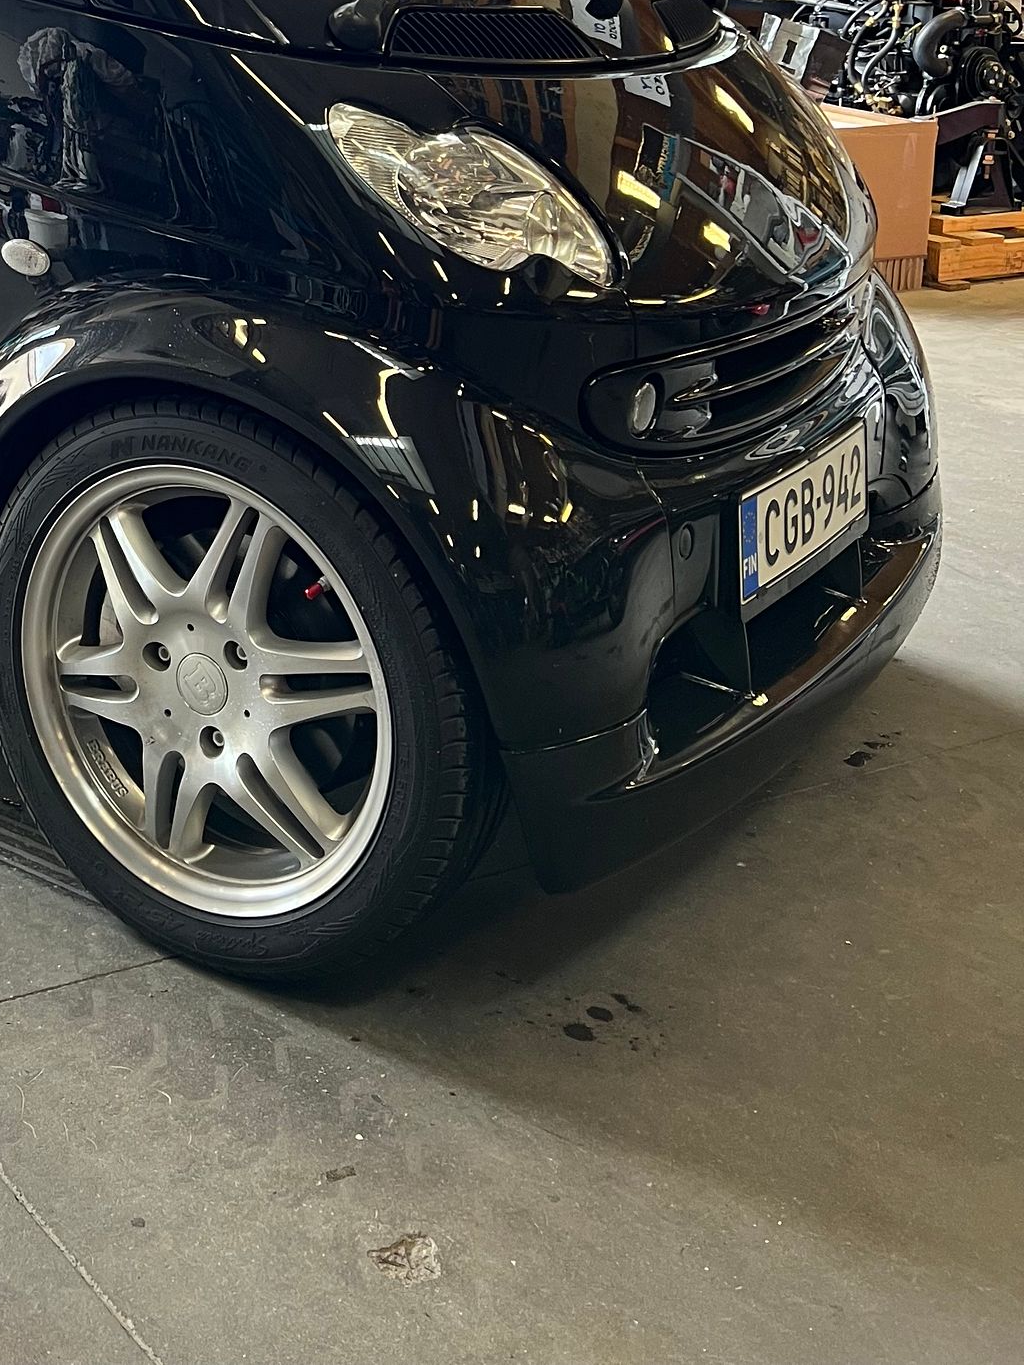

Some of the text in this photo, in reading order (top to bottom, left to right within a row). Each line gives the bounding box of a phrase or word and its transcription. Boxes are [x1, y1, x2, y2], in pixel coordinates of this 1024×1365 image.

[141, 433, 253, 473] NANKANG
[764, 444, 862, 567] CGB-942
[743, 552, 758, 580] FIN
[86, 738, 129, 799] BRABUS
